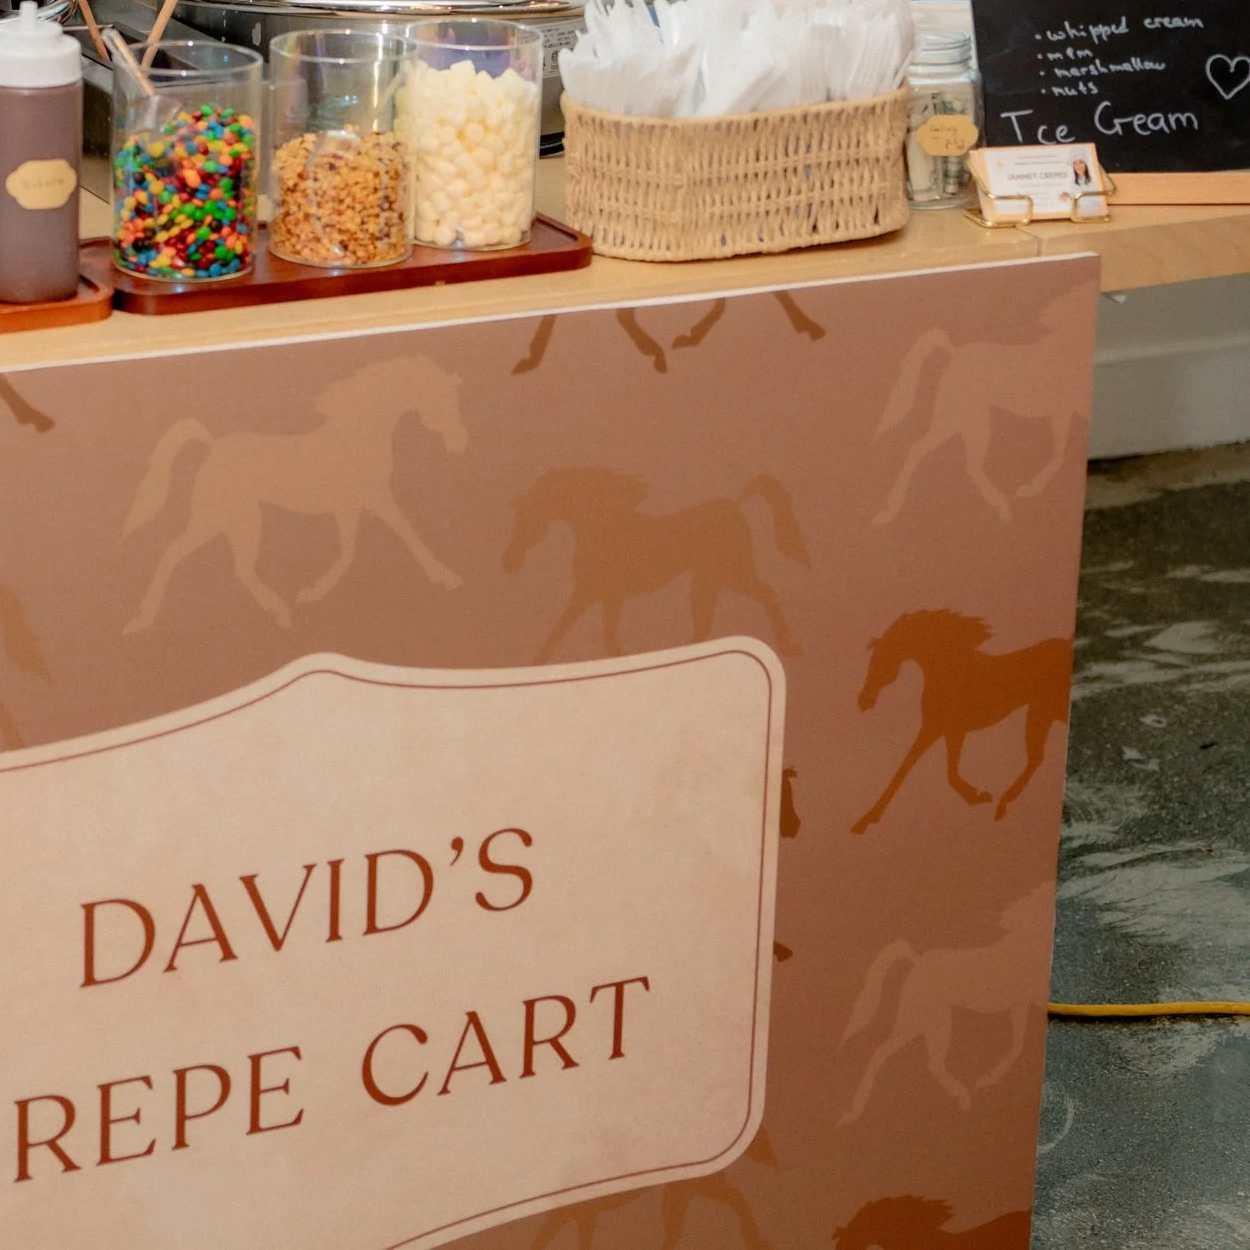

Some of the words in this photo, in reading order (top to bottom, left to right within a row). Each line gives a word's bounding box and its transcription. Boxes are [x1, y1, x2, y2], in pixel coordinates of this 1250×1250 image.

[1047, 15, 1129, 45] whipped
[1143, 16, 1204, 29] cream
[1052, 81, 1099, 96] nuts
[1094, 100, 1199, 136] Cream
[80, 827, 535, 988] DAVID'S
[361, 975, 651, 1107] CART
